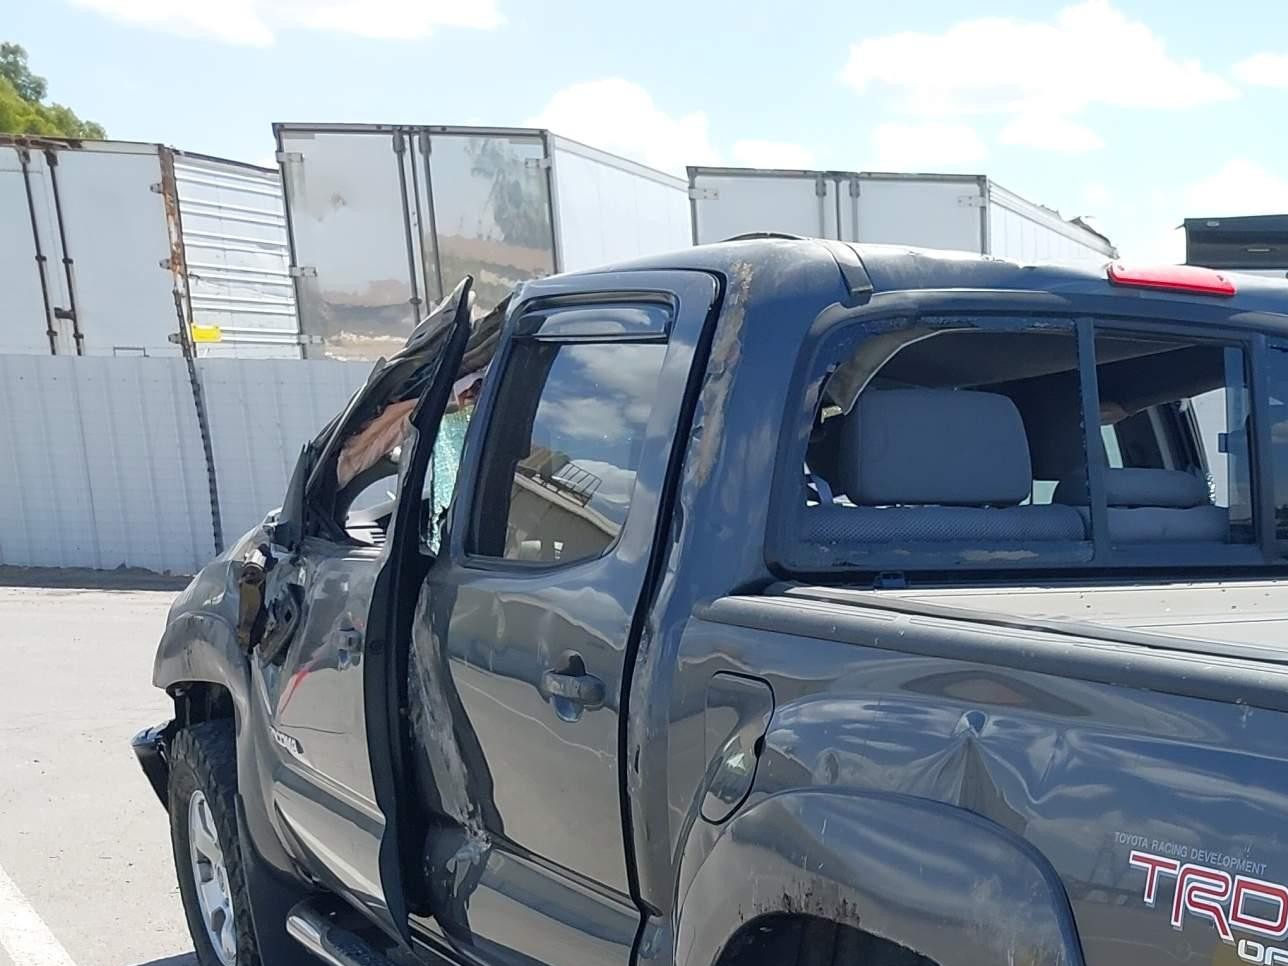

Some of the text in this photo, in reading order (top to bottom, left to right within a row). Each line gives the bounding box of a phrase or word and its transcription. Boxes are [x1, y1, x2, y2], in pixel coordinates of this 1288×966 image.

[1114, 831, 1268, 876] TOYOTA RACING DEVELOPMENT
